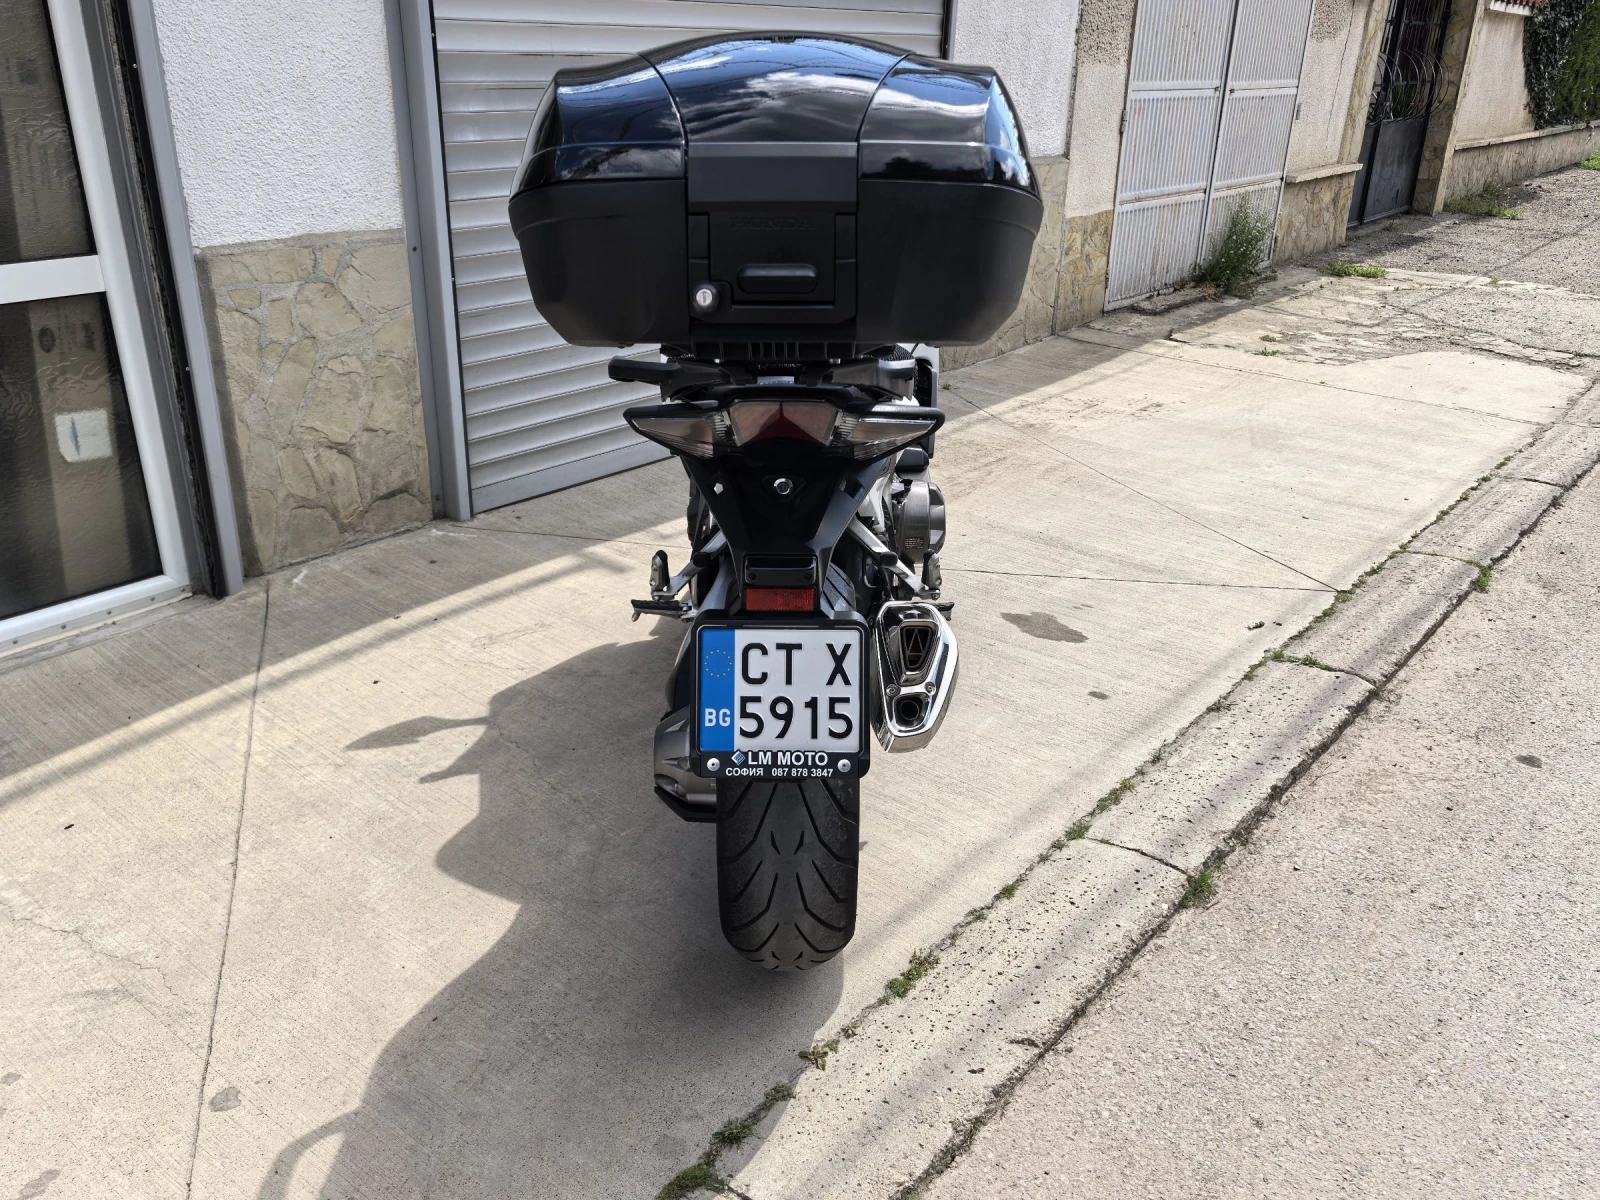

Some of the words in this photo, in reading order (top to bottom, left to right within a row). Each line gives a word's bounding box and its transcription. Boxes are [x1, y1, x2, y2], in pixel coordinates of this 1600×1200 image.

[729, 216, 816, 231] HONDA
[741, 642, 803, 686] CT
[825, 643, 853, 686] X
[704, 708, 731, 727] BG
[739, 695, 853, 740] 5915
[748, 751, 772, 765] LM
[777, 751, 828, 766] MOTO
[725, 767, 764, 777] СОФИЯ
[771, 768, 788, 777] 087
[791, 768, 808, 777] 878
[810, 768, 834, 778] 3847
